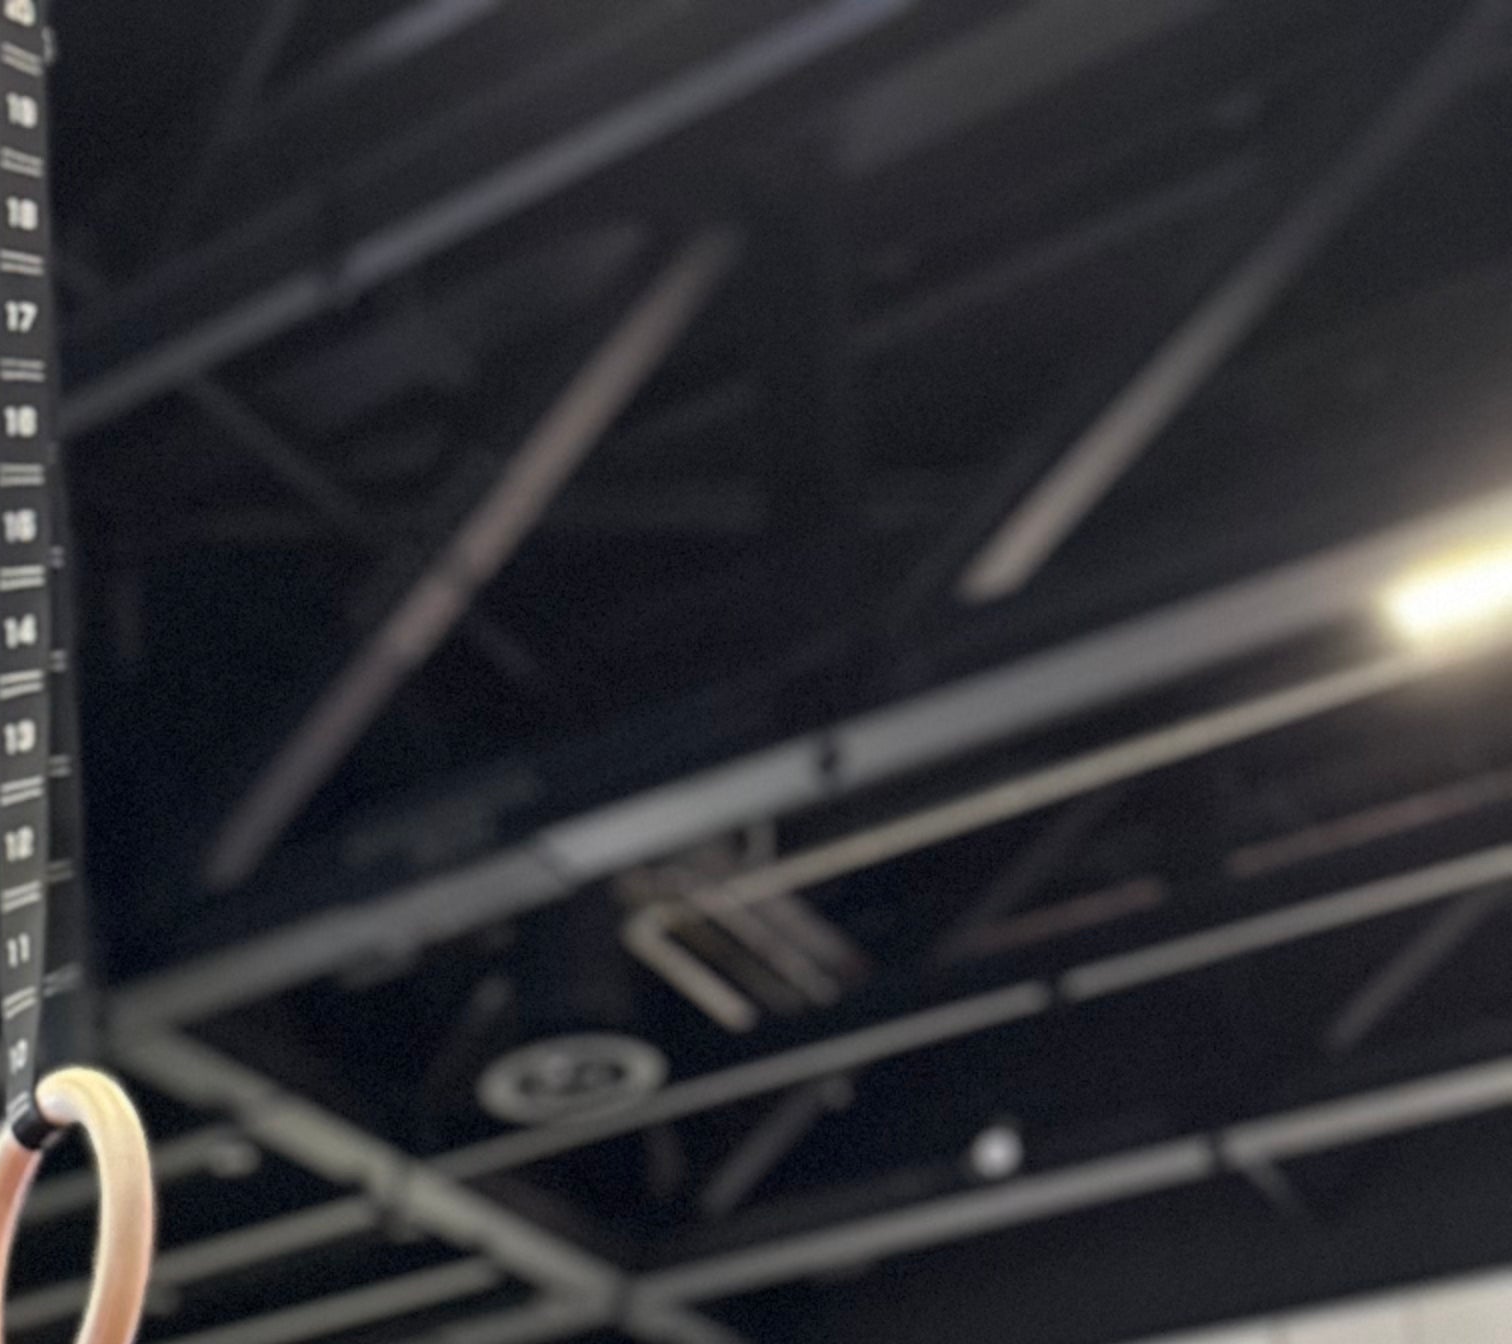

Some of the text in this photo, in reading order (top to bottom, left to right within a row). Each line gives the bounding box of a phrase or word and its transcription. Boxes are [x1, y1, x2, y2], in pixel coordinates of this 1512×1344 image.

[5, 301, 38, 333] 17
[3, 613, 37, 649] 14
[7, 932, 31, 968] 11
